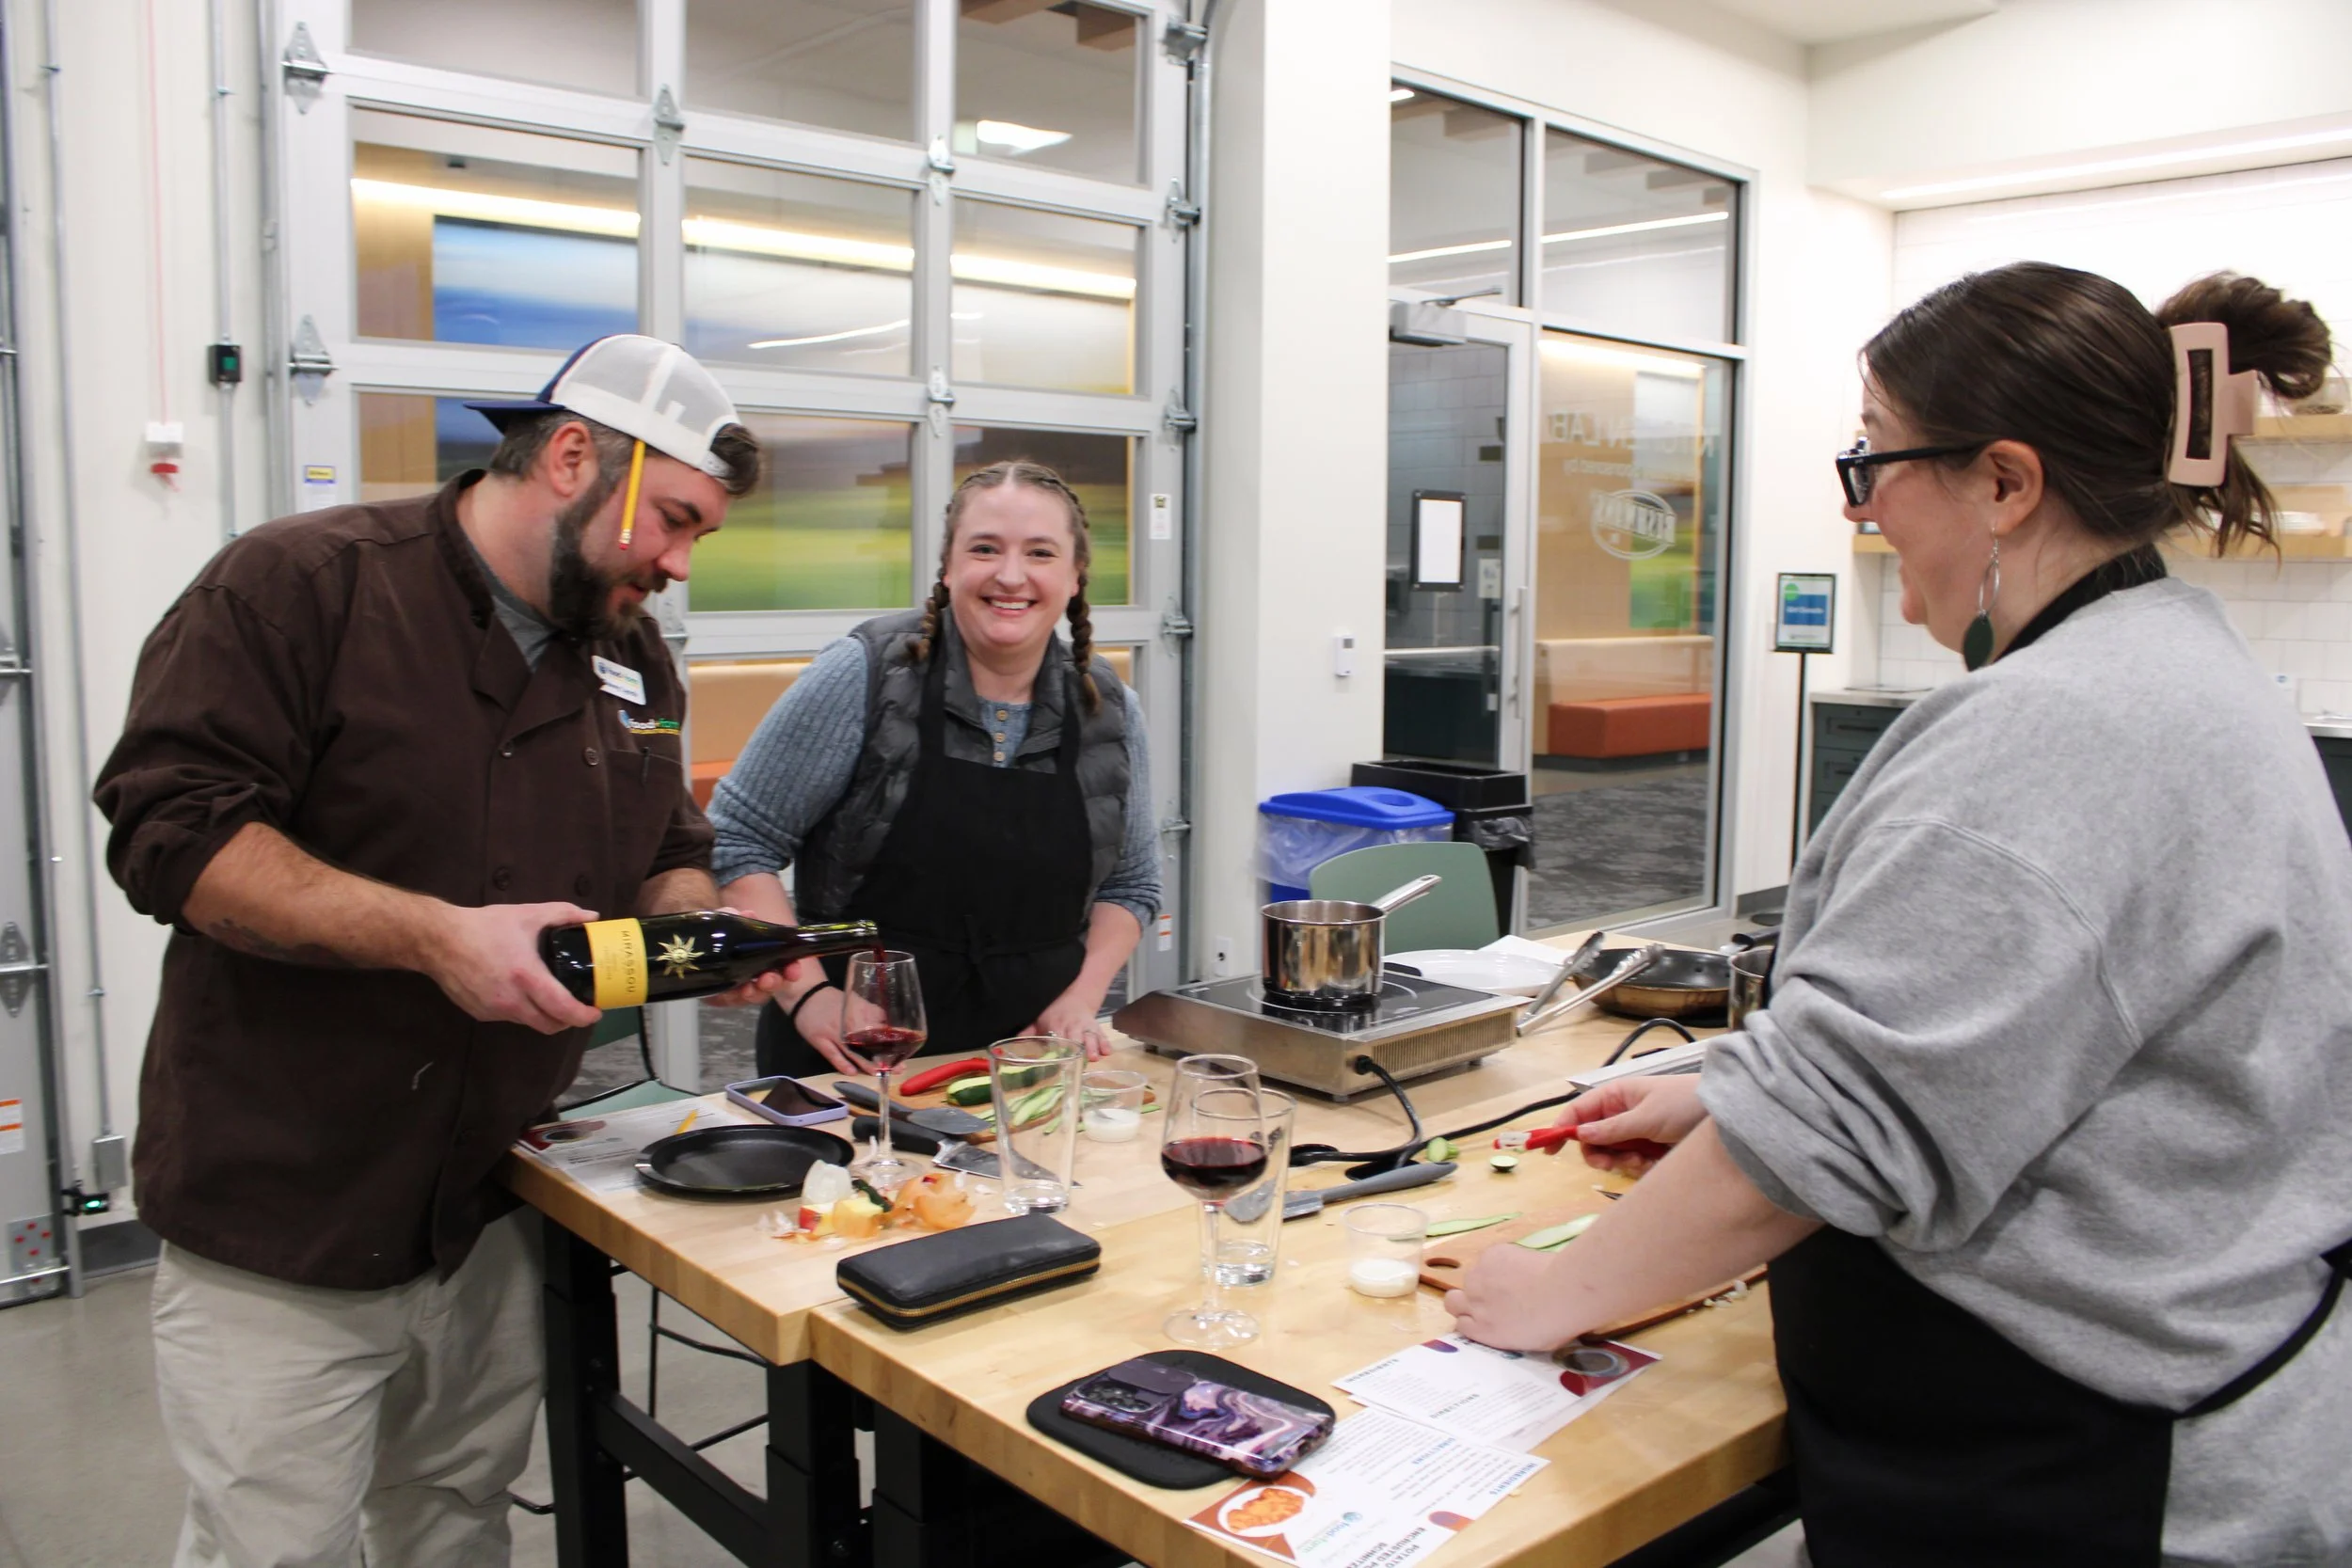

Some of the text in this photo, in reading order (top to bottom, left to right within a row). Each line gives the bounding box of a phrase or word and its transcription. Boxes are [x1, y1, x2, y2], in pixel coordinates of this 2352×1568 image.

[621, 930, 636, 992] MIRASSOU
[1346, 1542, 1389, 1568] SCHNITZ
[1377, 1527, 1426, 1562] ENCRUSTED
[1385, 1544, 1421, 1568] POTATO
